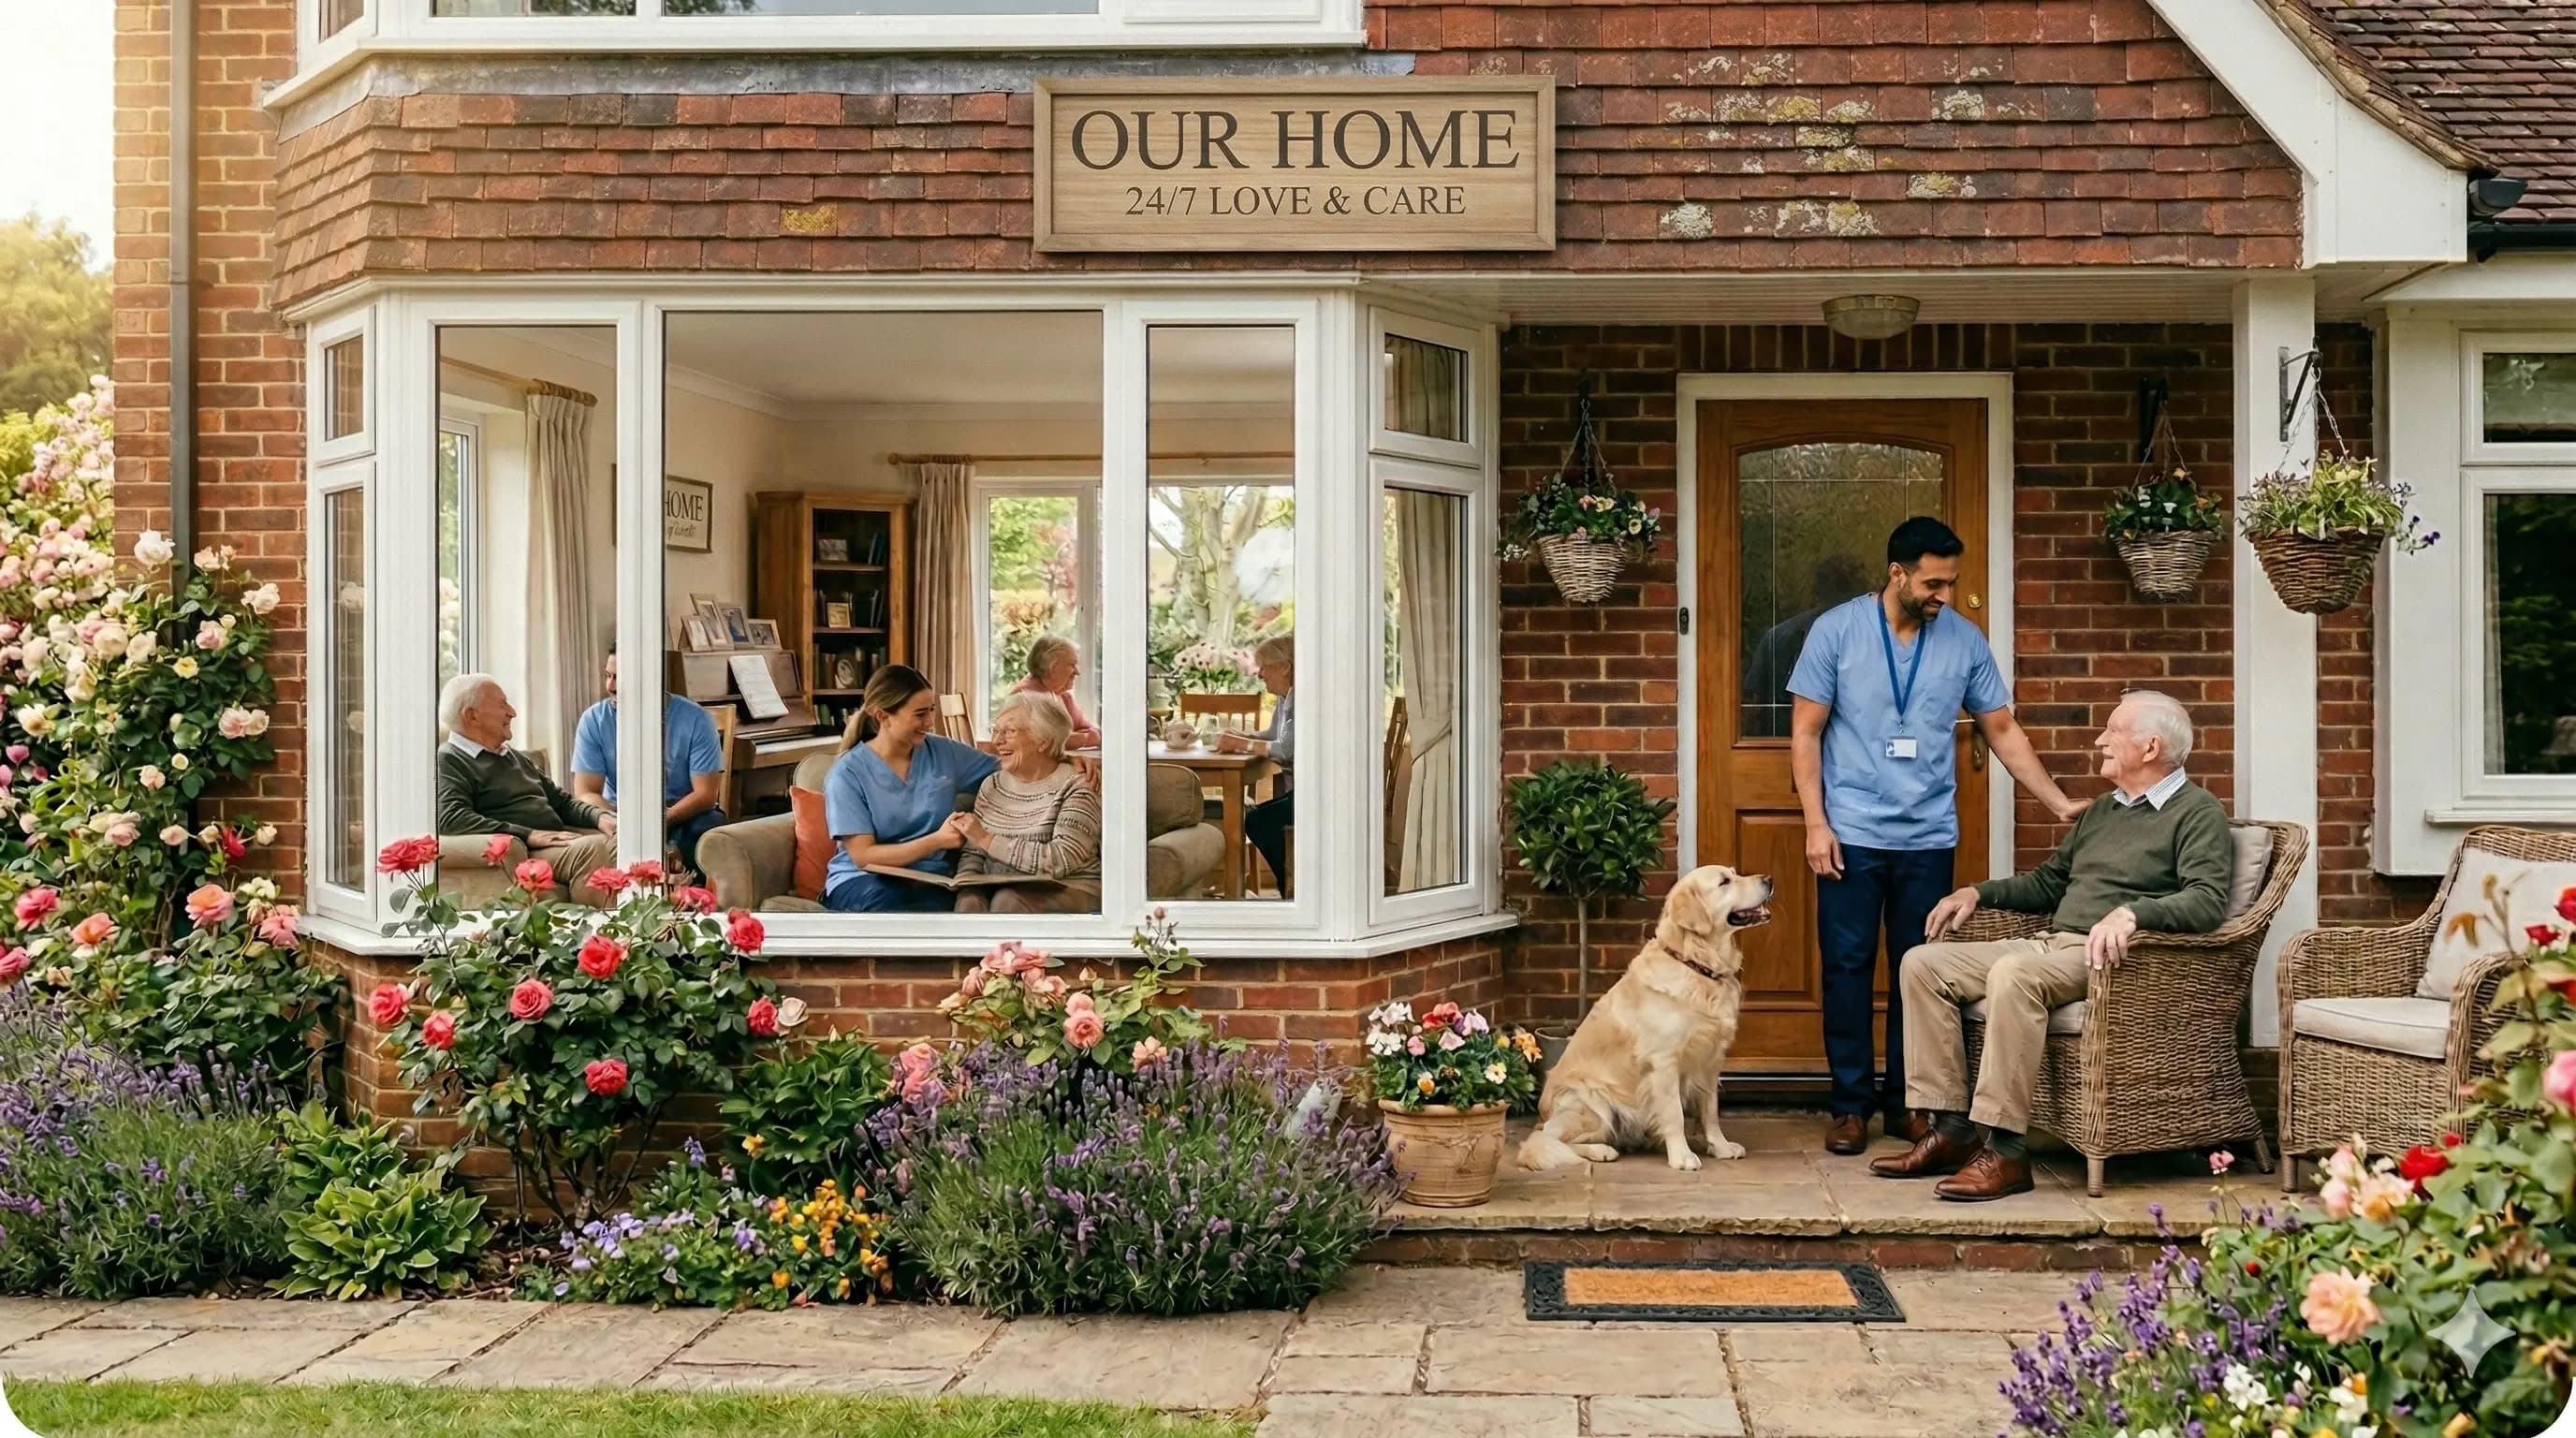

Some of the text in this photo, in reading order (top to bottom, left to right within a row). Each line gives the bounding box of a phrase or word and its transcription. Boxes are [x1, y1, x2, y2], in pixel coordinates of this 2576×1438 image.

[1071, 110, 1520, 170] OUR HOME
[1125, 185, 1467, 216] 24/7 LOVE & CARE
